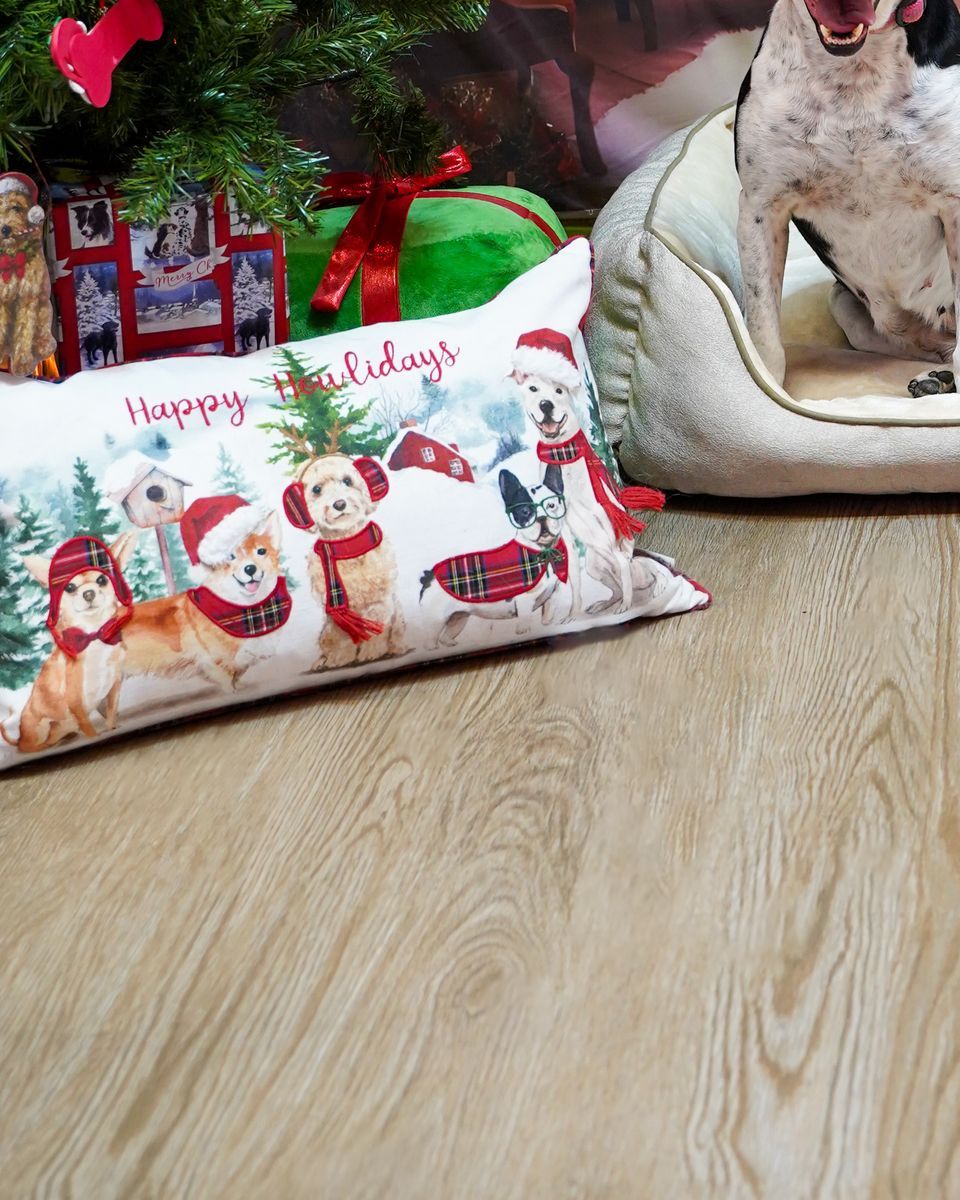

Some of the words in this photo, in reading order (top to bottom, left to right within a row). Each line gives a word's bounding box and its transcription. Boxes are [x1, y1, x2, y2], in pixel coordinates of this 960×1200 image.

[155, 271, 192, 288] Merry
[125, 390, 248, 430] Happy
[273, 340, 461, 402] Howlidays
